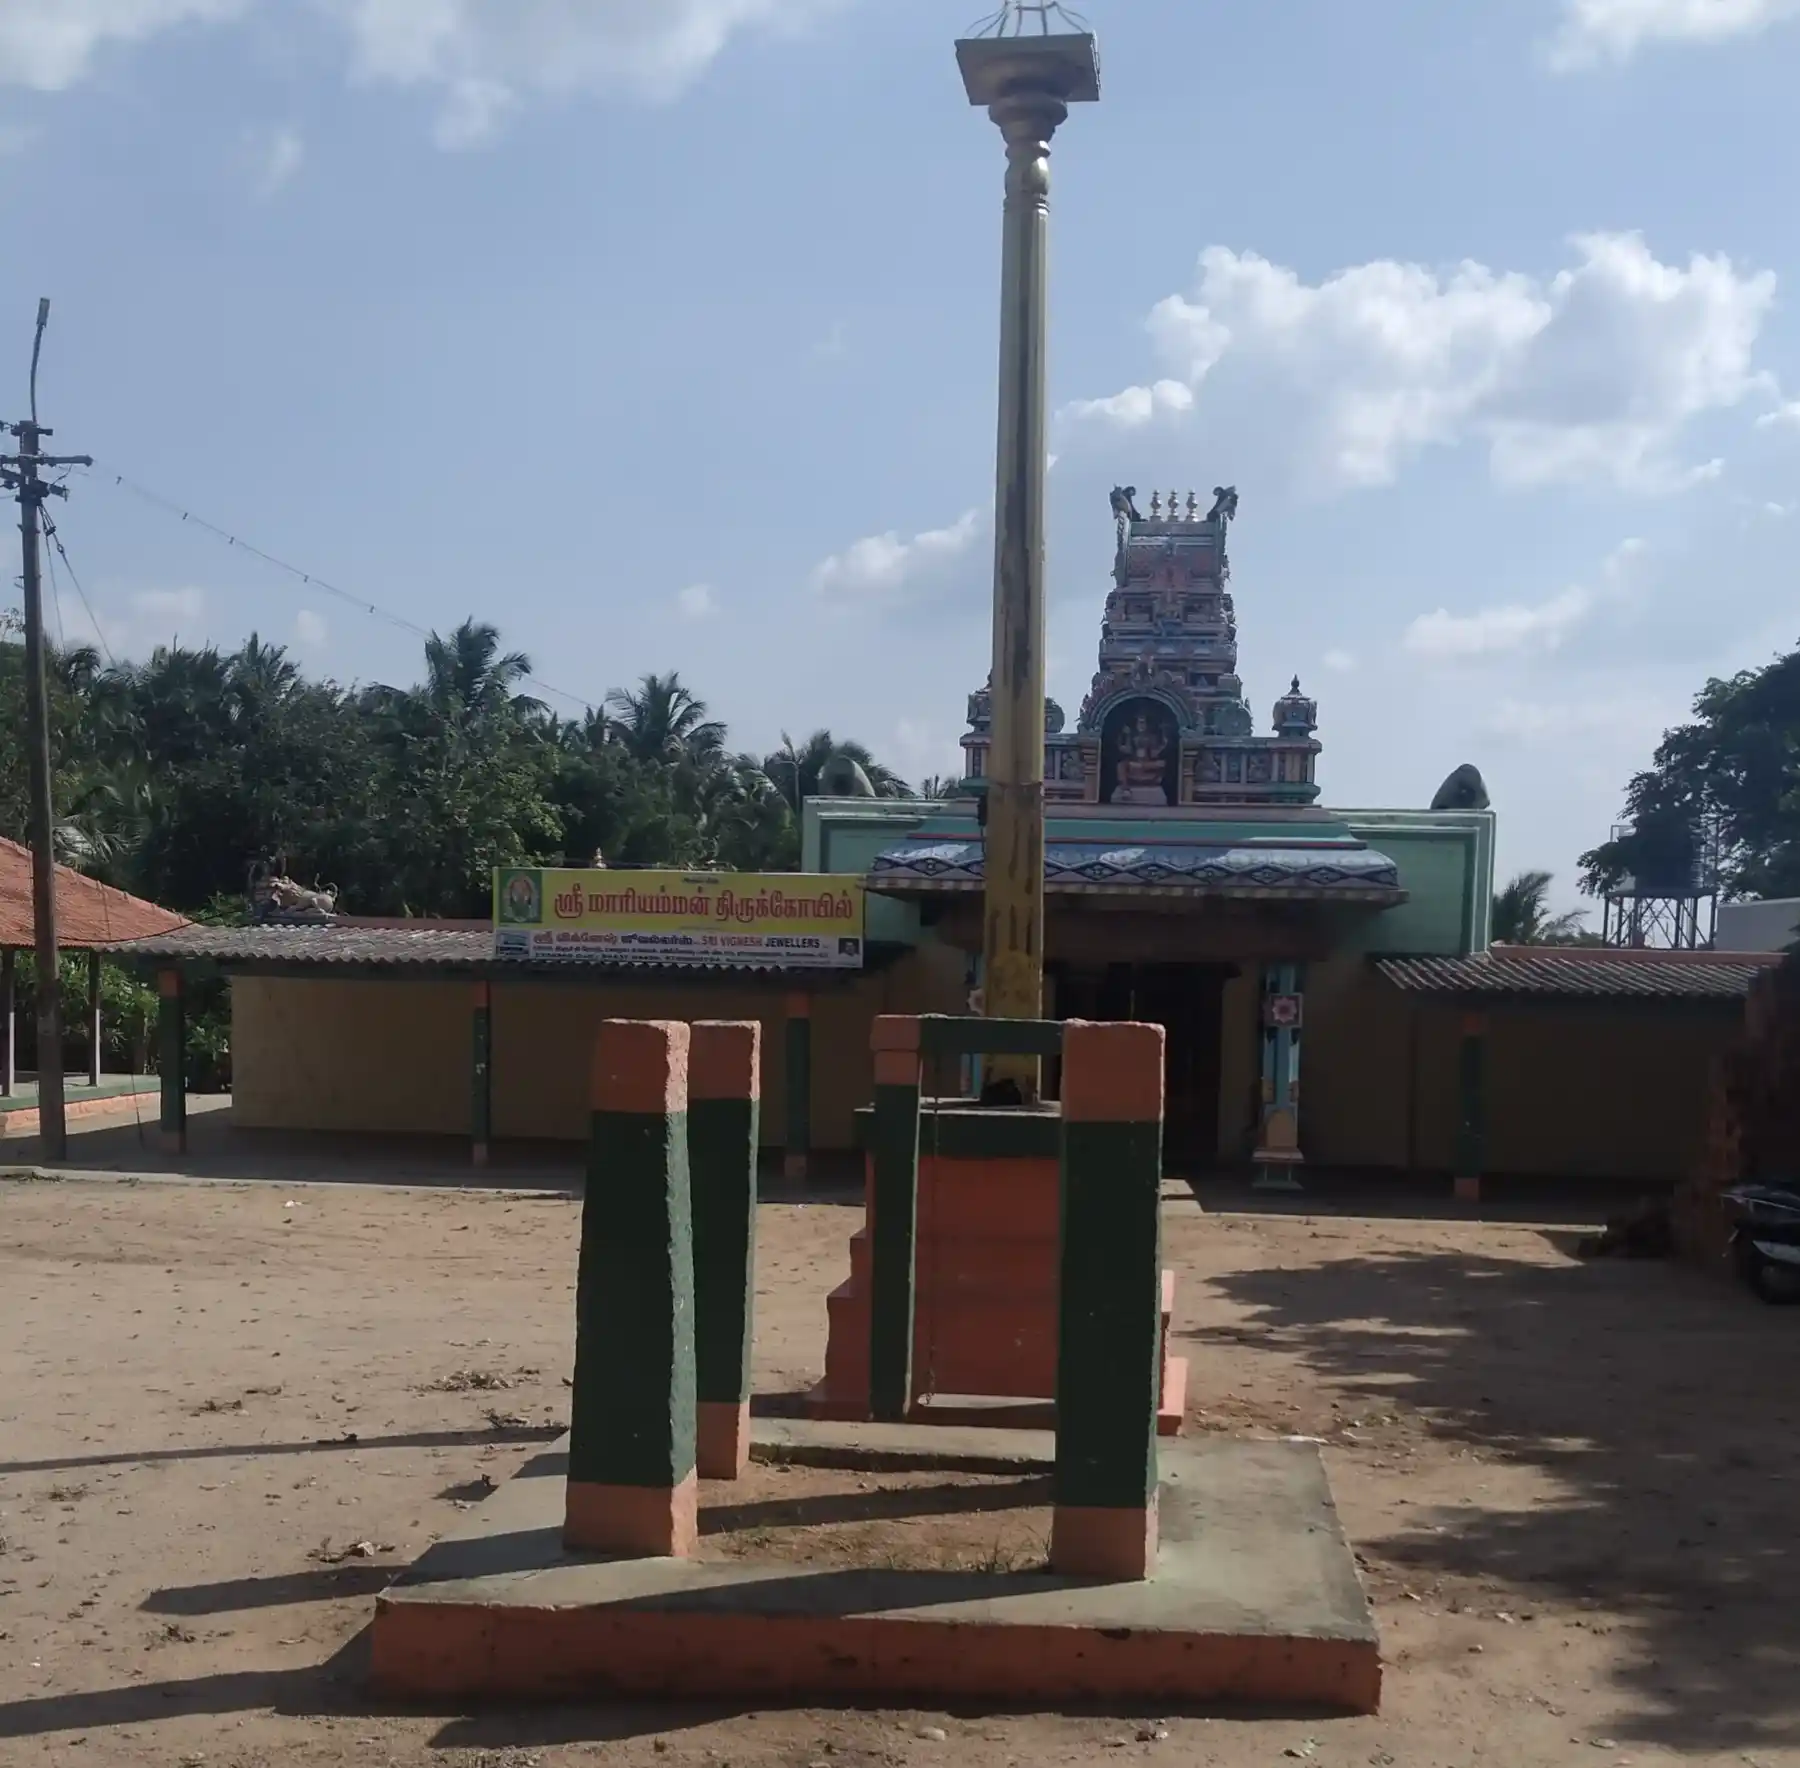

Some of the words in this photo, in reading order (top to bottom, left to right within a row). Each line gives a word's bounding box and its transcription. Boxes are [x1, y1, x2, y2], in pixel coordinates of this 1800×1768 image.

[588, 885, 711, 915] மாரியம்மன்
[716, 889, 853, 923] திருக்கோயில்
[702, 935, 718, 946] SRI
[720, 936, 763, 947] VIGNESH
[765, 937, 821, 949] JEWELLERS
